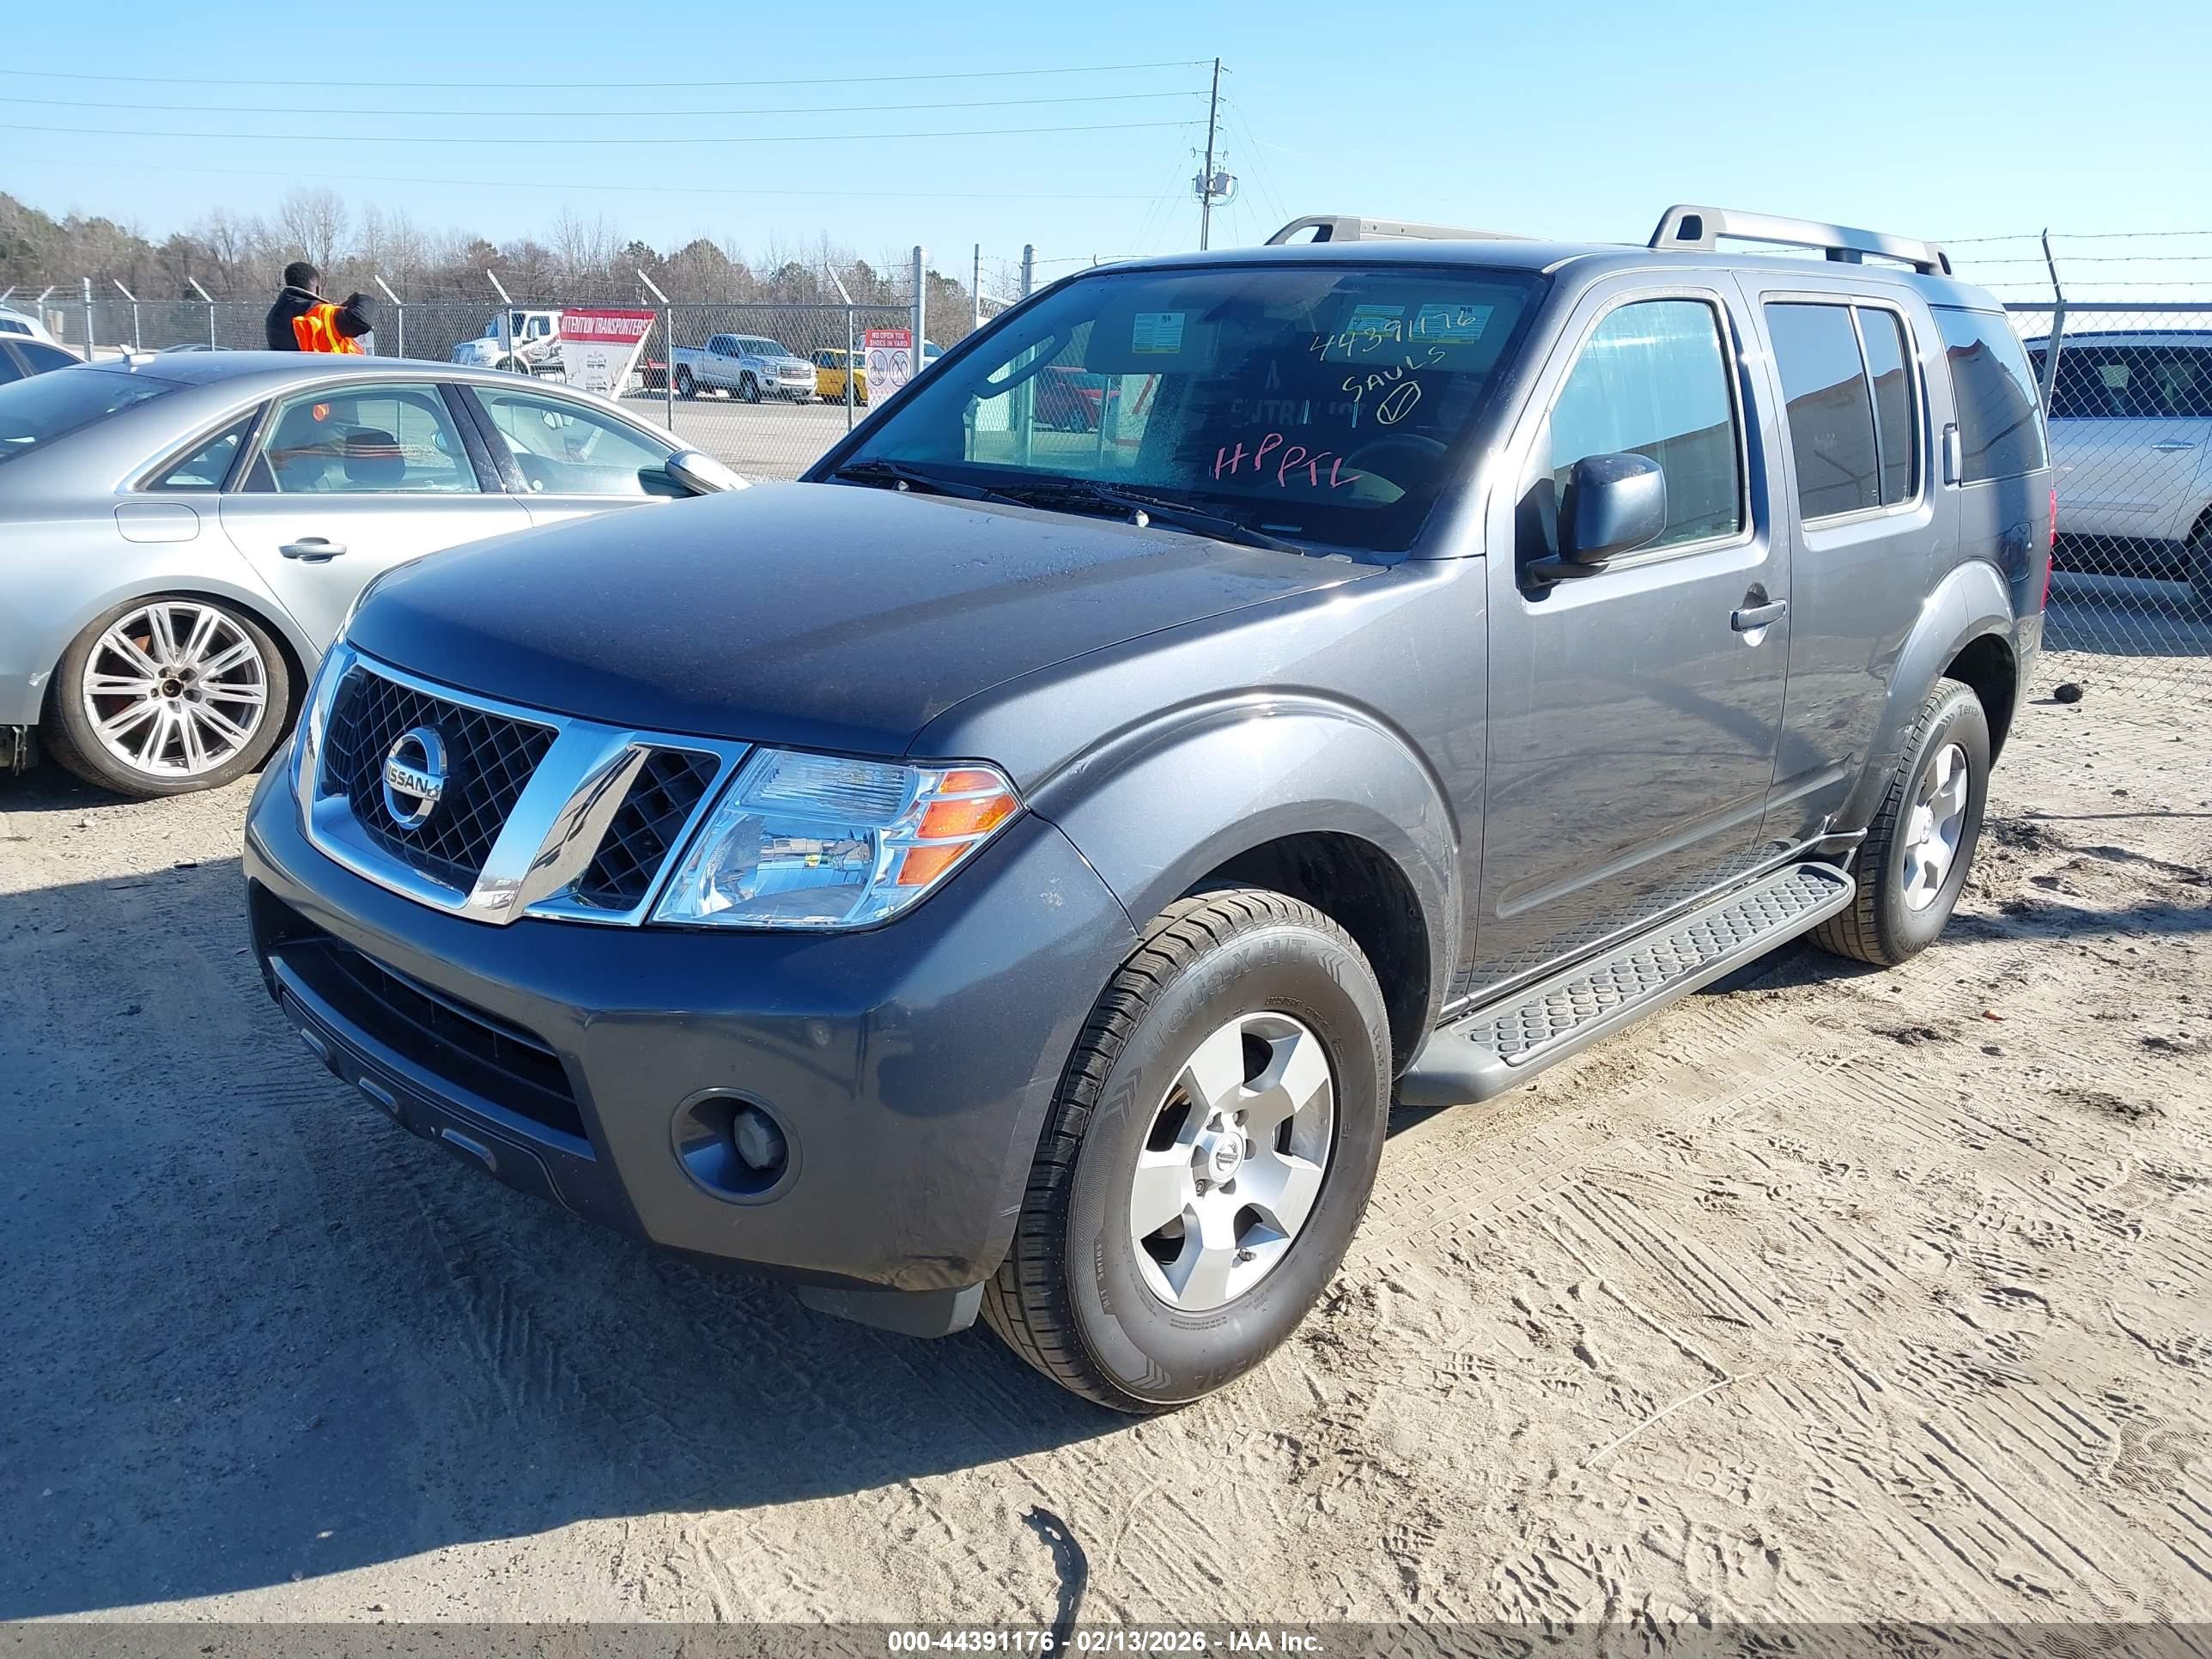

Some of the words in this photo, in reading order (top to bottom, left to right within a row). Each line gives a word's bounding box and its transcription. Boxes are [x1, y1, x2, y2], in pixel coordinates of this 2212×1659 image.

[562, 315, 594, 334] ATTENTION
[895, 331, 905, 340] TOE
[1310, 309, 1478, 362] 44391176
[1341, 347, 1448, 403] SAULS
